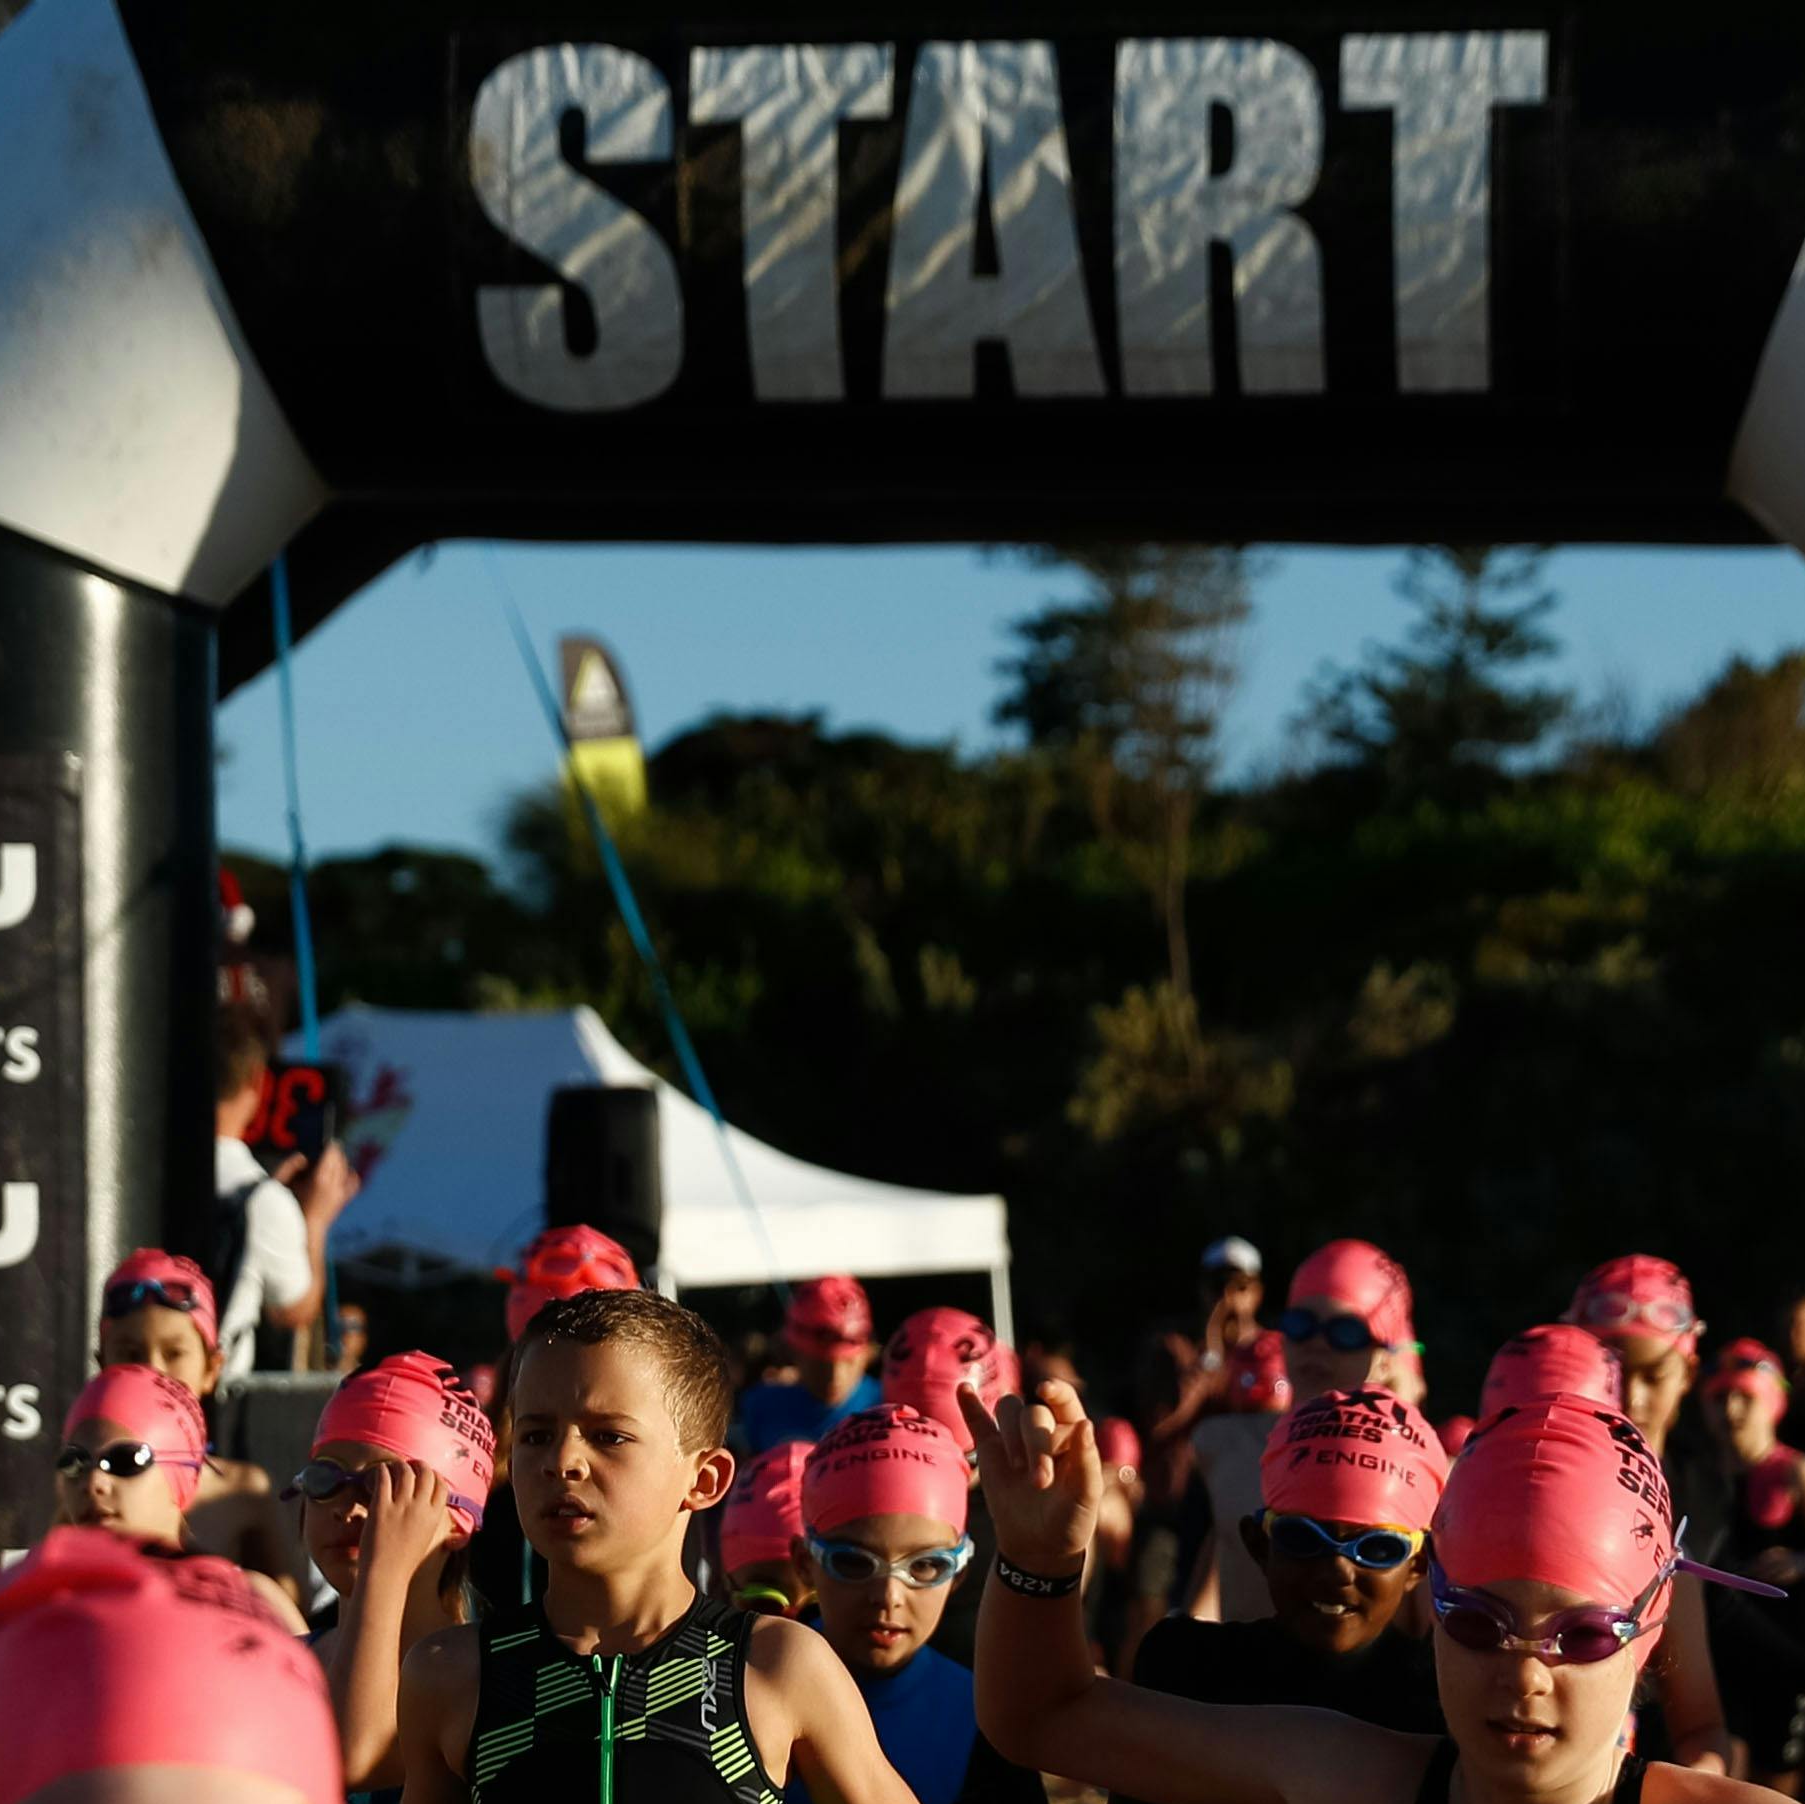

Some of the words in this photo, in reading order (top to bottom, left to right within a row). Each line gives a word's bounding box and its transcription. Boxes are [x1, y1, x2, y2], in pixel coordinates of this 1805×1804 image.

[468, 31, 1549, 412] START
[439, 1410, 495, 1458] SERIE
[833, 1448, 937, 1470] ENGINE
[1315, 1451, 1417, 1488] ENGINE
[701, 1657, 717, 1733] 2XU
